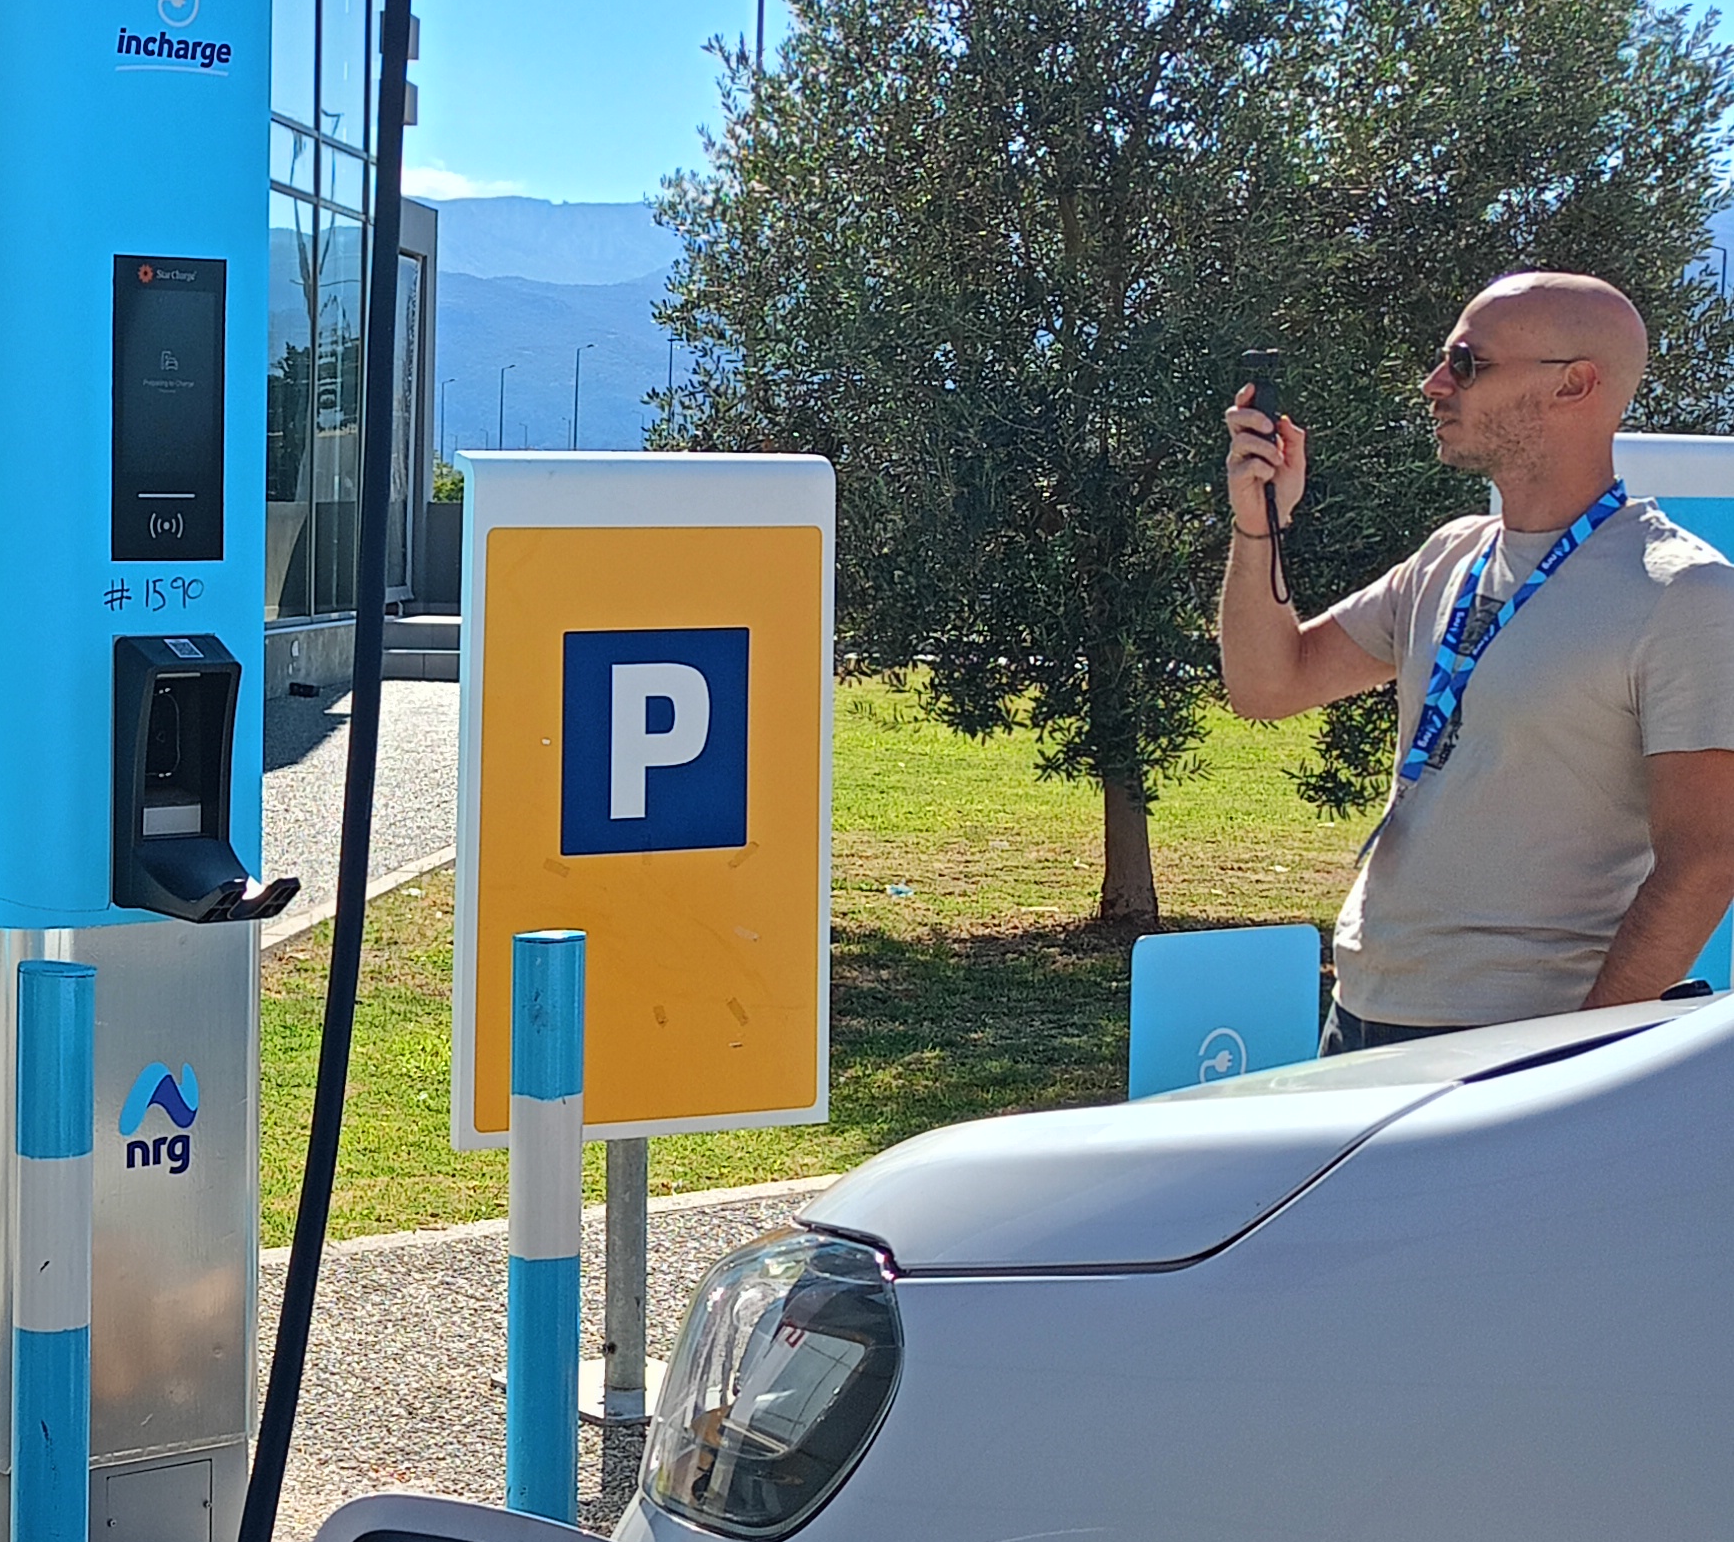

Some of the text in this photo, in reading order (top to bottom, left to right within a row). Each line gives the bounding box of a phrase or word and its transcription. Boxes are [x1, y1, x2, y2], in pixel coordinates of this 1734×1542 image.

[116, 27, 232, 69] incharge
[609, 662, 711, 820] P
[126, 1133, 191, 1175] nrg
